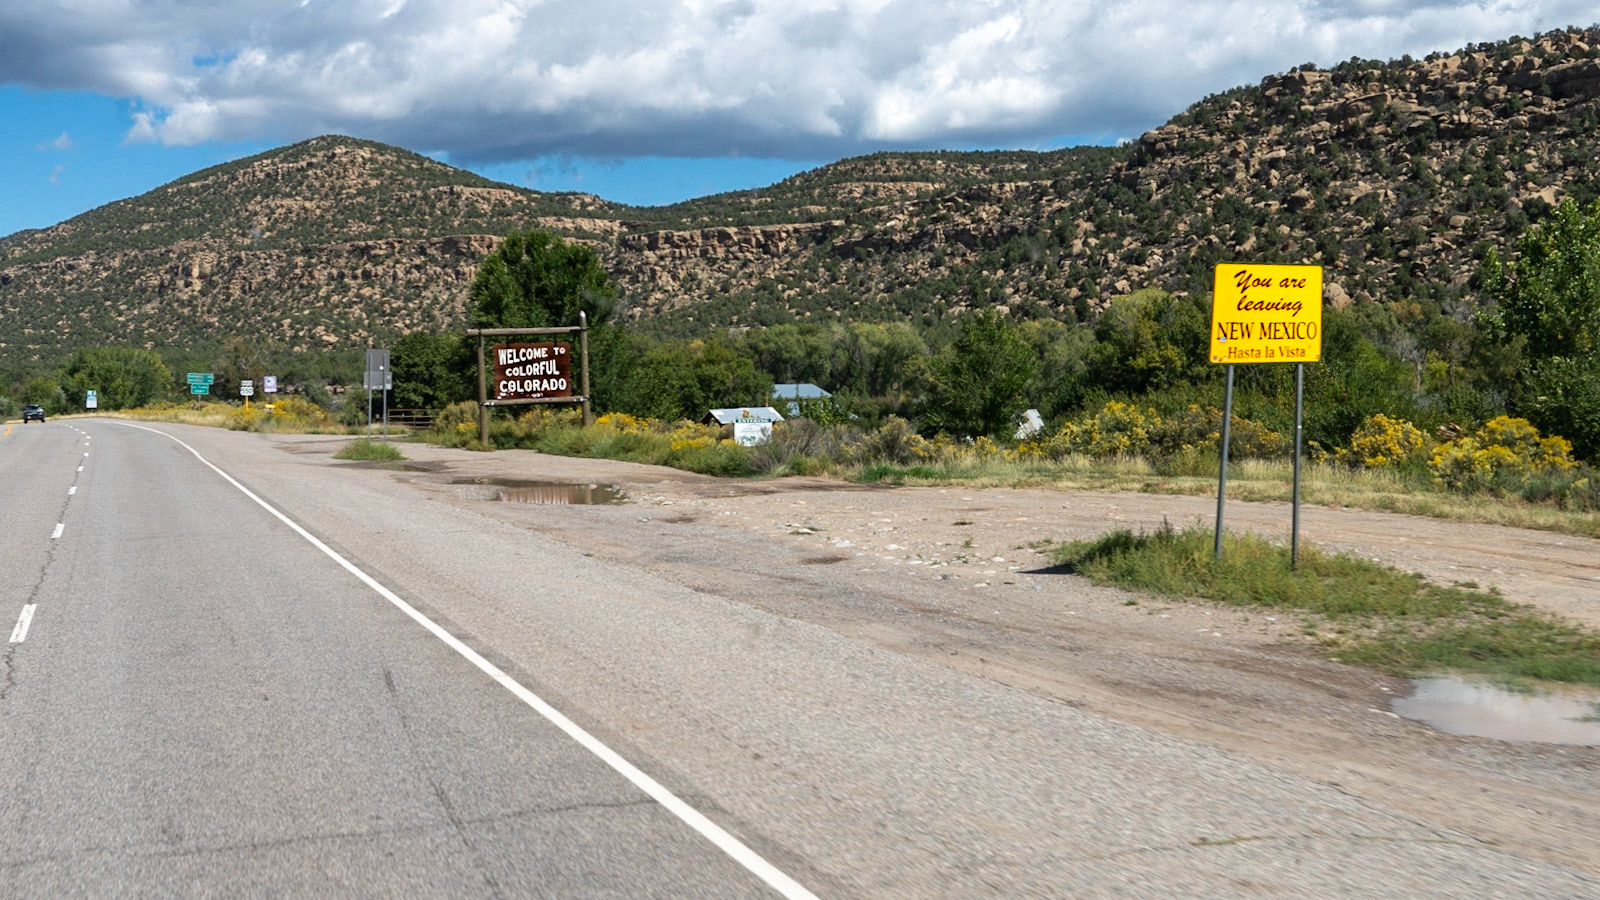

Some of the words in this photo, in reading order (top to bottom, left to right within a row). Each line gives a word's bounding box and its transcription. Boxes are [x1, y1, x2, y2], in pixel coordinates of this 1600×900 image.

[1234, 270, 1272, 294] You
[1279, 277, 1306, 288] are
[1237, 295, 1303, 317] leaving
[1217, 322, 1254, 340] NEW
[1259, 321, 1317, 340] MEXICO
[498, 347, 548, 365] WELCOME
[553, 347, 566, 355] TO
[1228, 346, 1261, 359] Hasta
[1265, 346, 1275, 358] la
[1279, 346, 1306, 358] Vista
[505, 359, 560, 376] COLORFUL
[241, 387, 253, 395] 550
[499, 378, 567, 392] COLORADO
